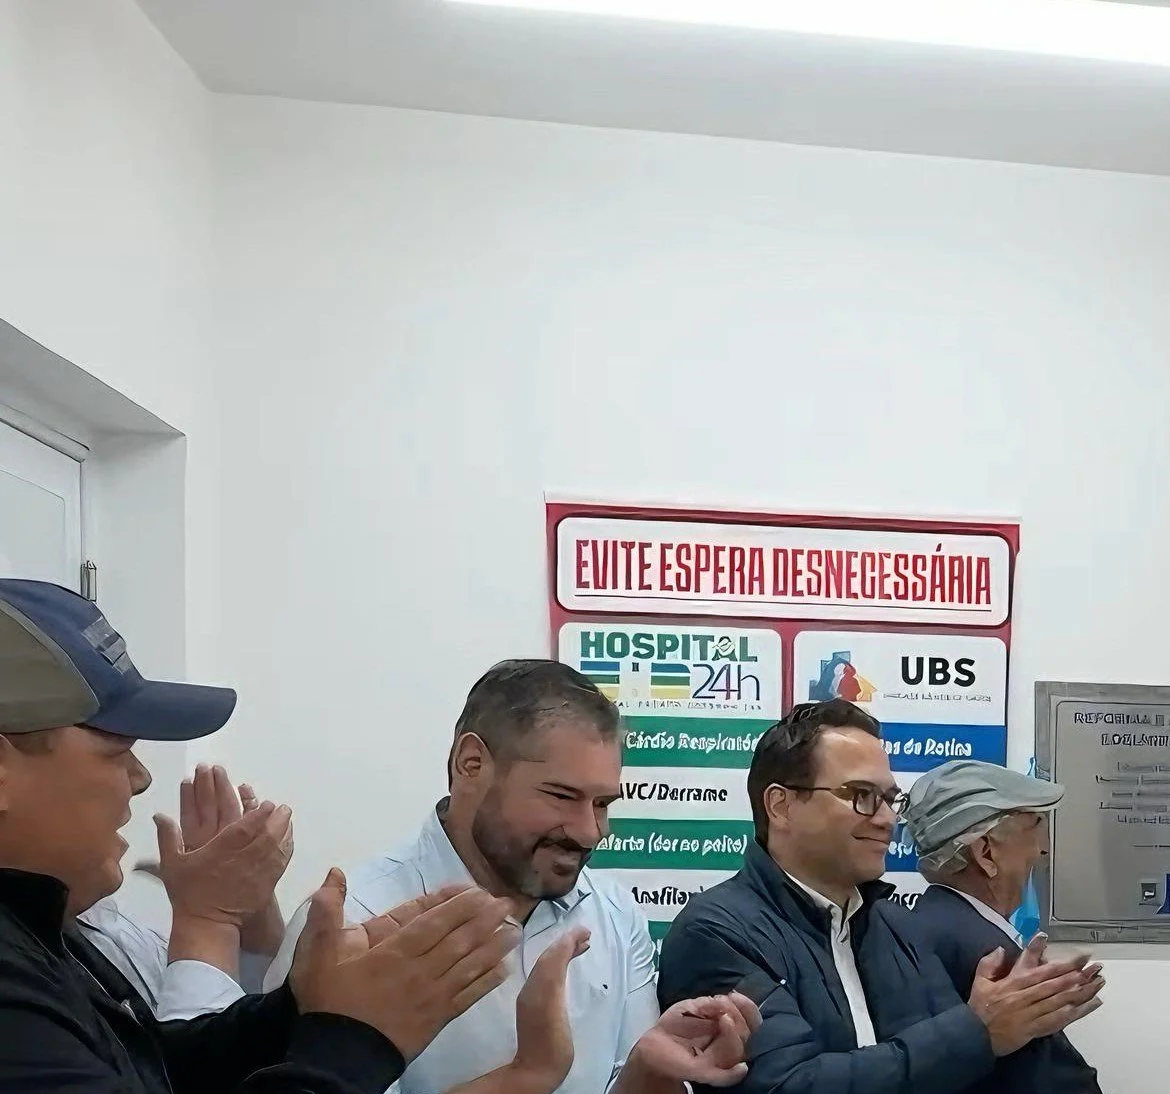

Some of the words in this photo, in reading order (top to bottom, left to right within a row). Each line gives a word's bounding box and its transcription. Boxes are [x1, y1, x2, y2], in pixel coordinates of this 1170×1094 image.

[575, 538, 652, 592] EVITE
[659, 542, 765, 597] ESPERA
[772, 543, 992, 605] DESNECESSÁRIA
[580, 631, 758, 663] HOSPITAL
[692, 663, 760, 701] 24h
[901, 655, 976, 688] UBS
